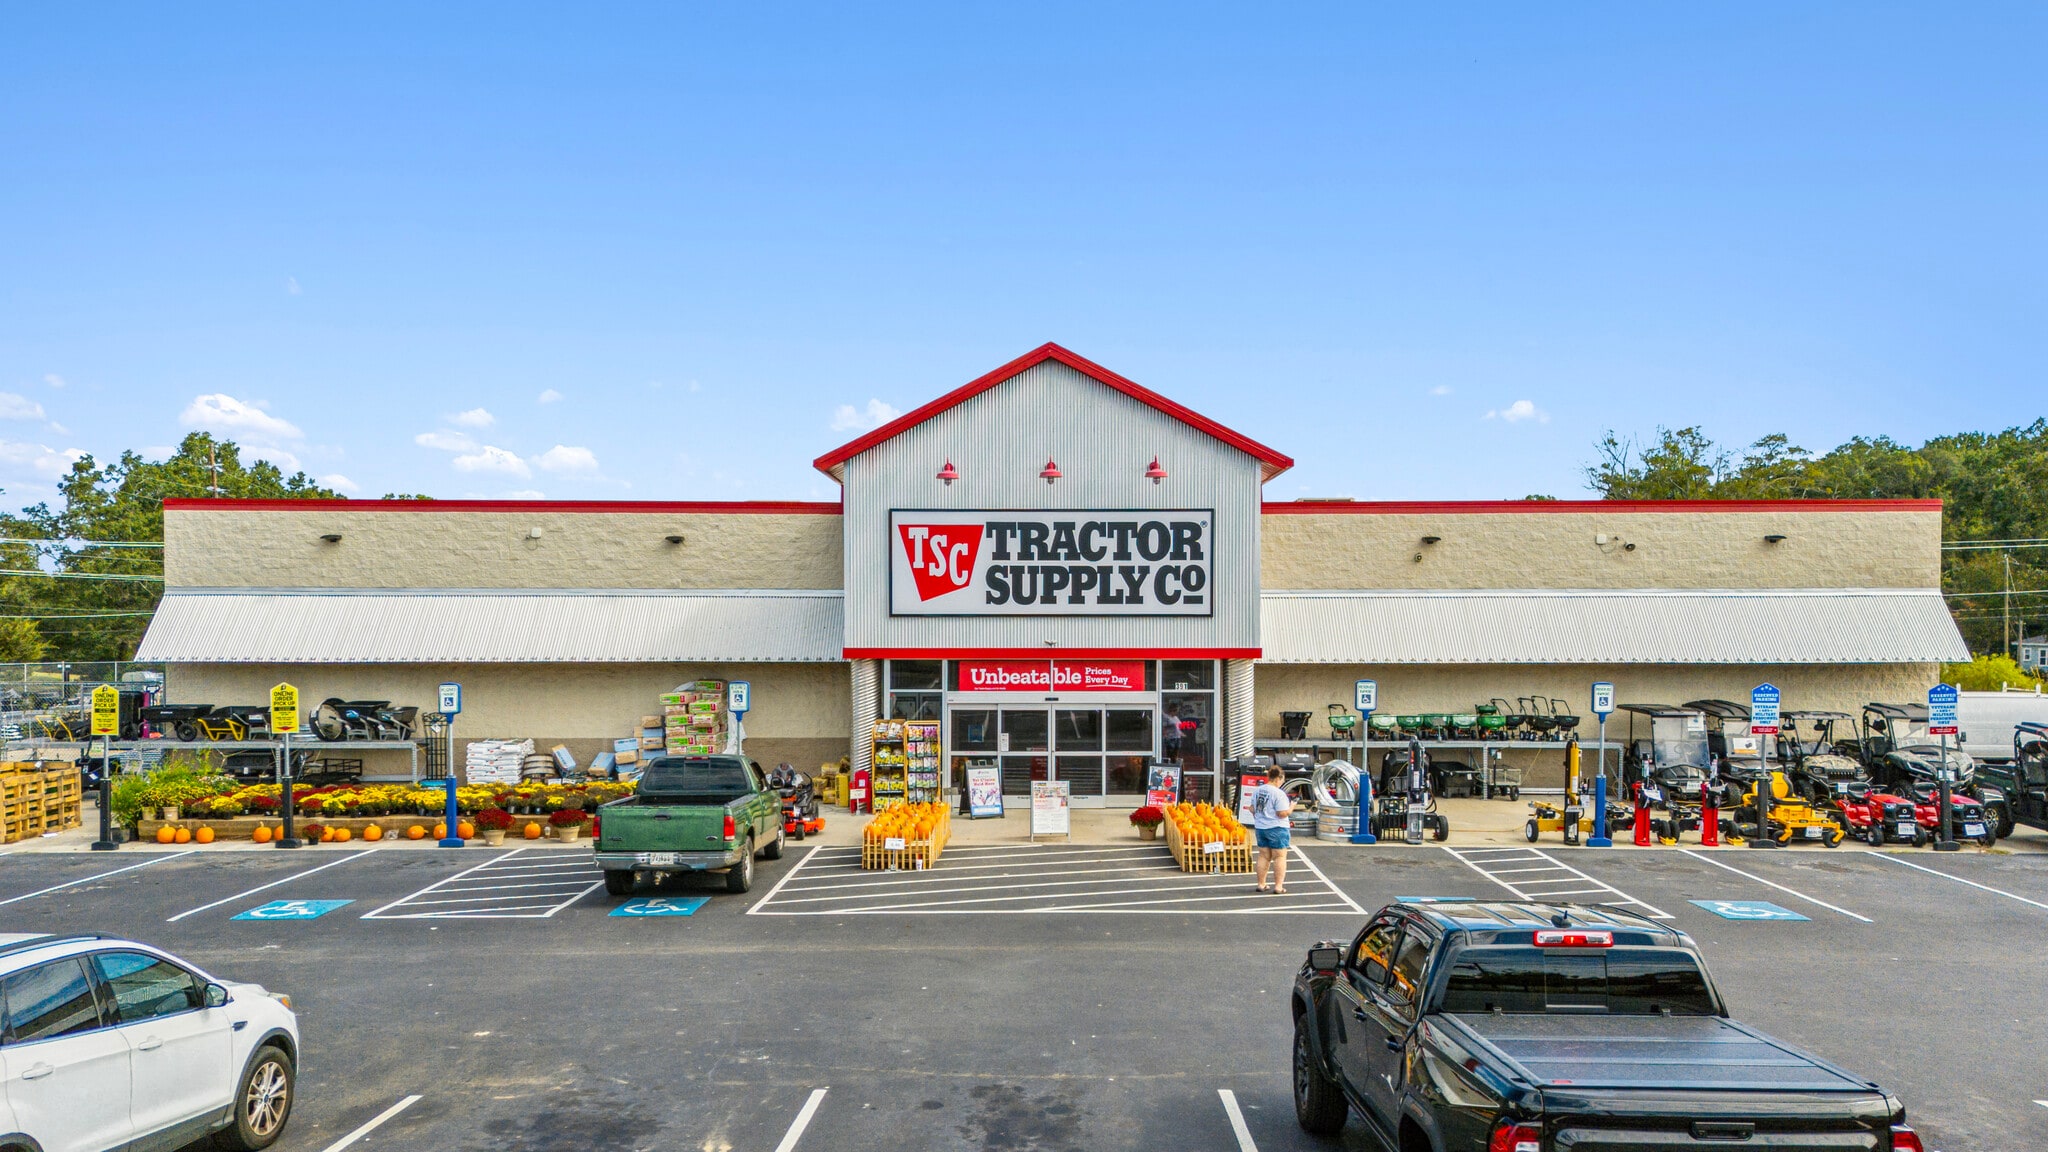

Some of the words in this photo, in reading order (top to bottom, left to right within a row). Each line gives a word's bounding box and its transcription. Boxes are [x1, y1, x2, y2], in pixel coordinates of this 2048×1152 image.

[985, 521, 1204, 561] TRACTOR
[908, 527, 969, 586] TSC
[985, 565, 1149, 605] SUPPLY
[971, 667, 1081, 685] Unbeatable
[1085, 667, 1112, 675] Prices
[1085, 676, 1108, 685] Every
[1111, 676, 1128, 685] Day
